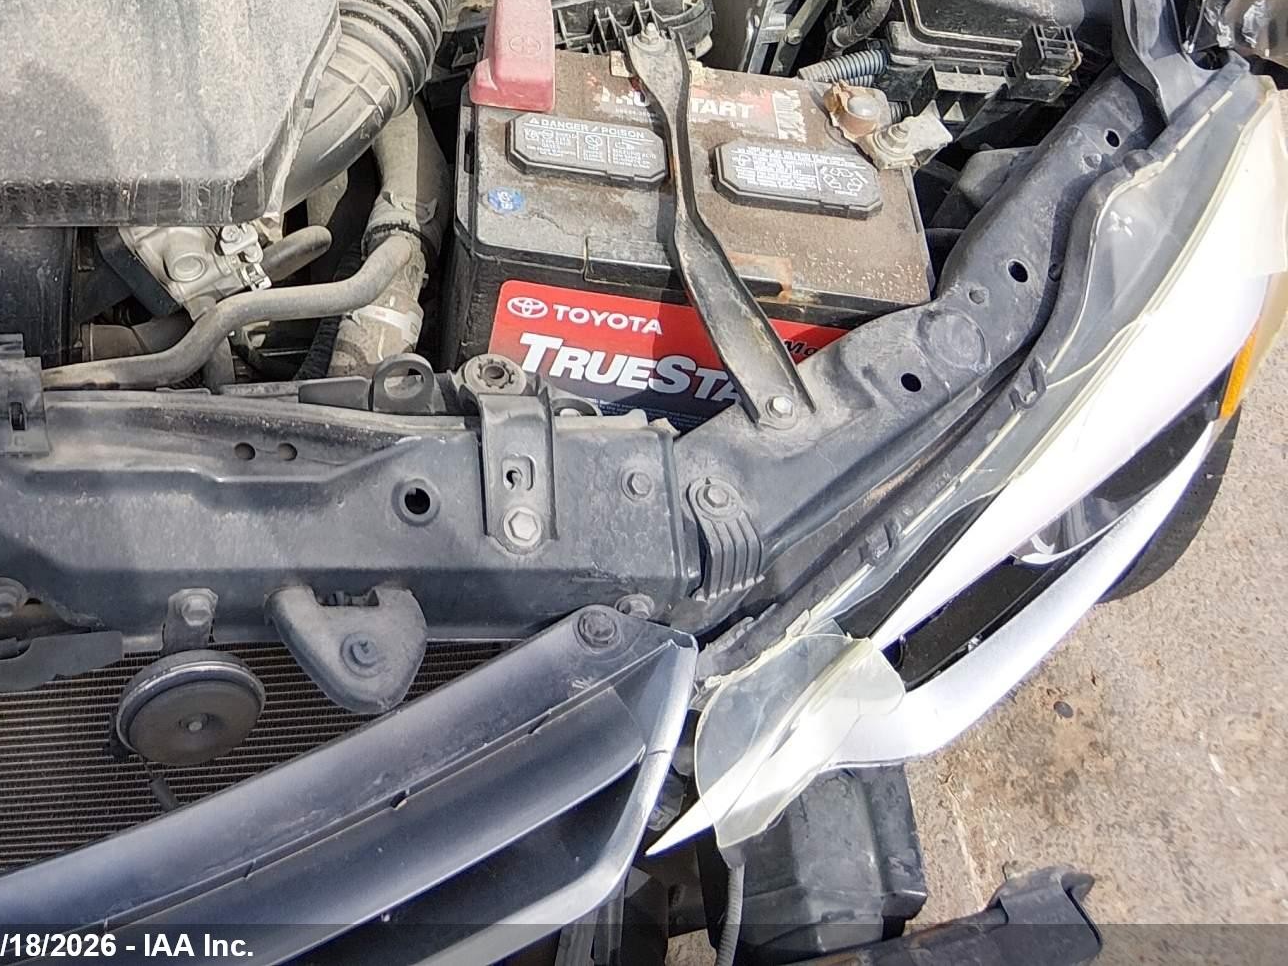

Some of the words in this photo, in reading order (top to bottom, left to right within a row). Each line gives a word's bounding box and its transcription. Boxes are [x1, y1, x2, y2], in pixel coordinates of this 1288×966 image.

[541, 119, 589, 132] DANGER
[601, 126, 645, 138] POISON
[552, 303, 663, 335] TOYOTA
